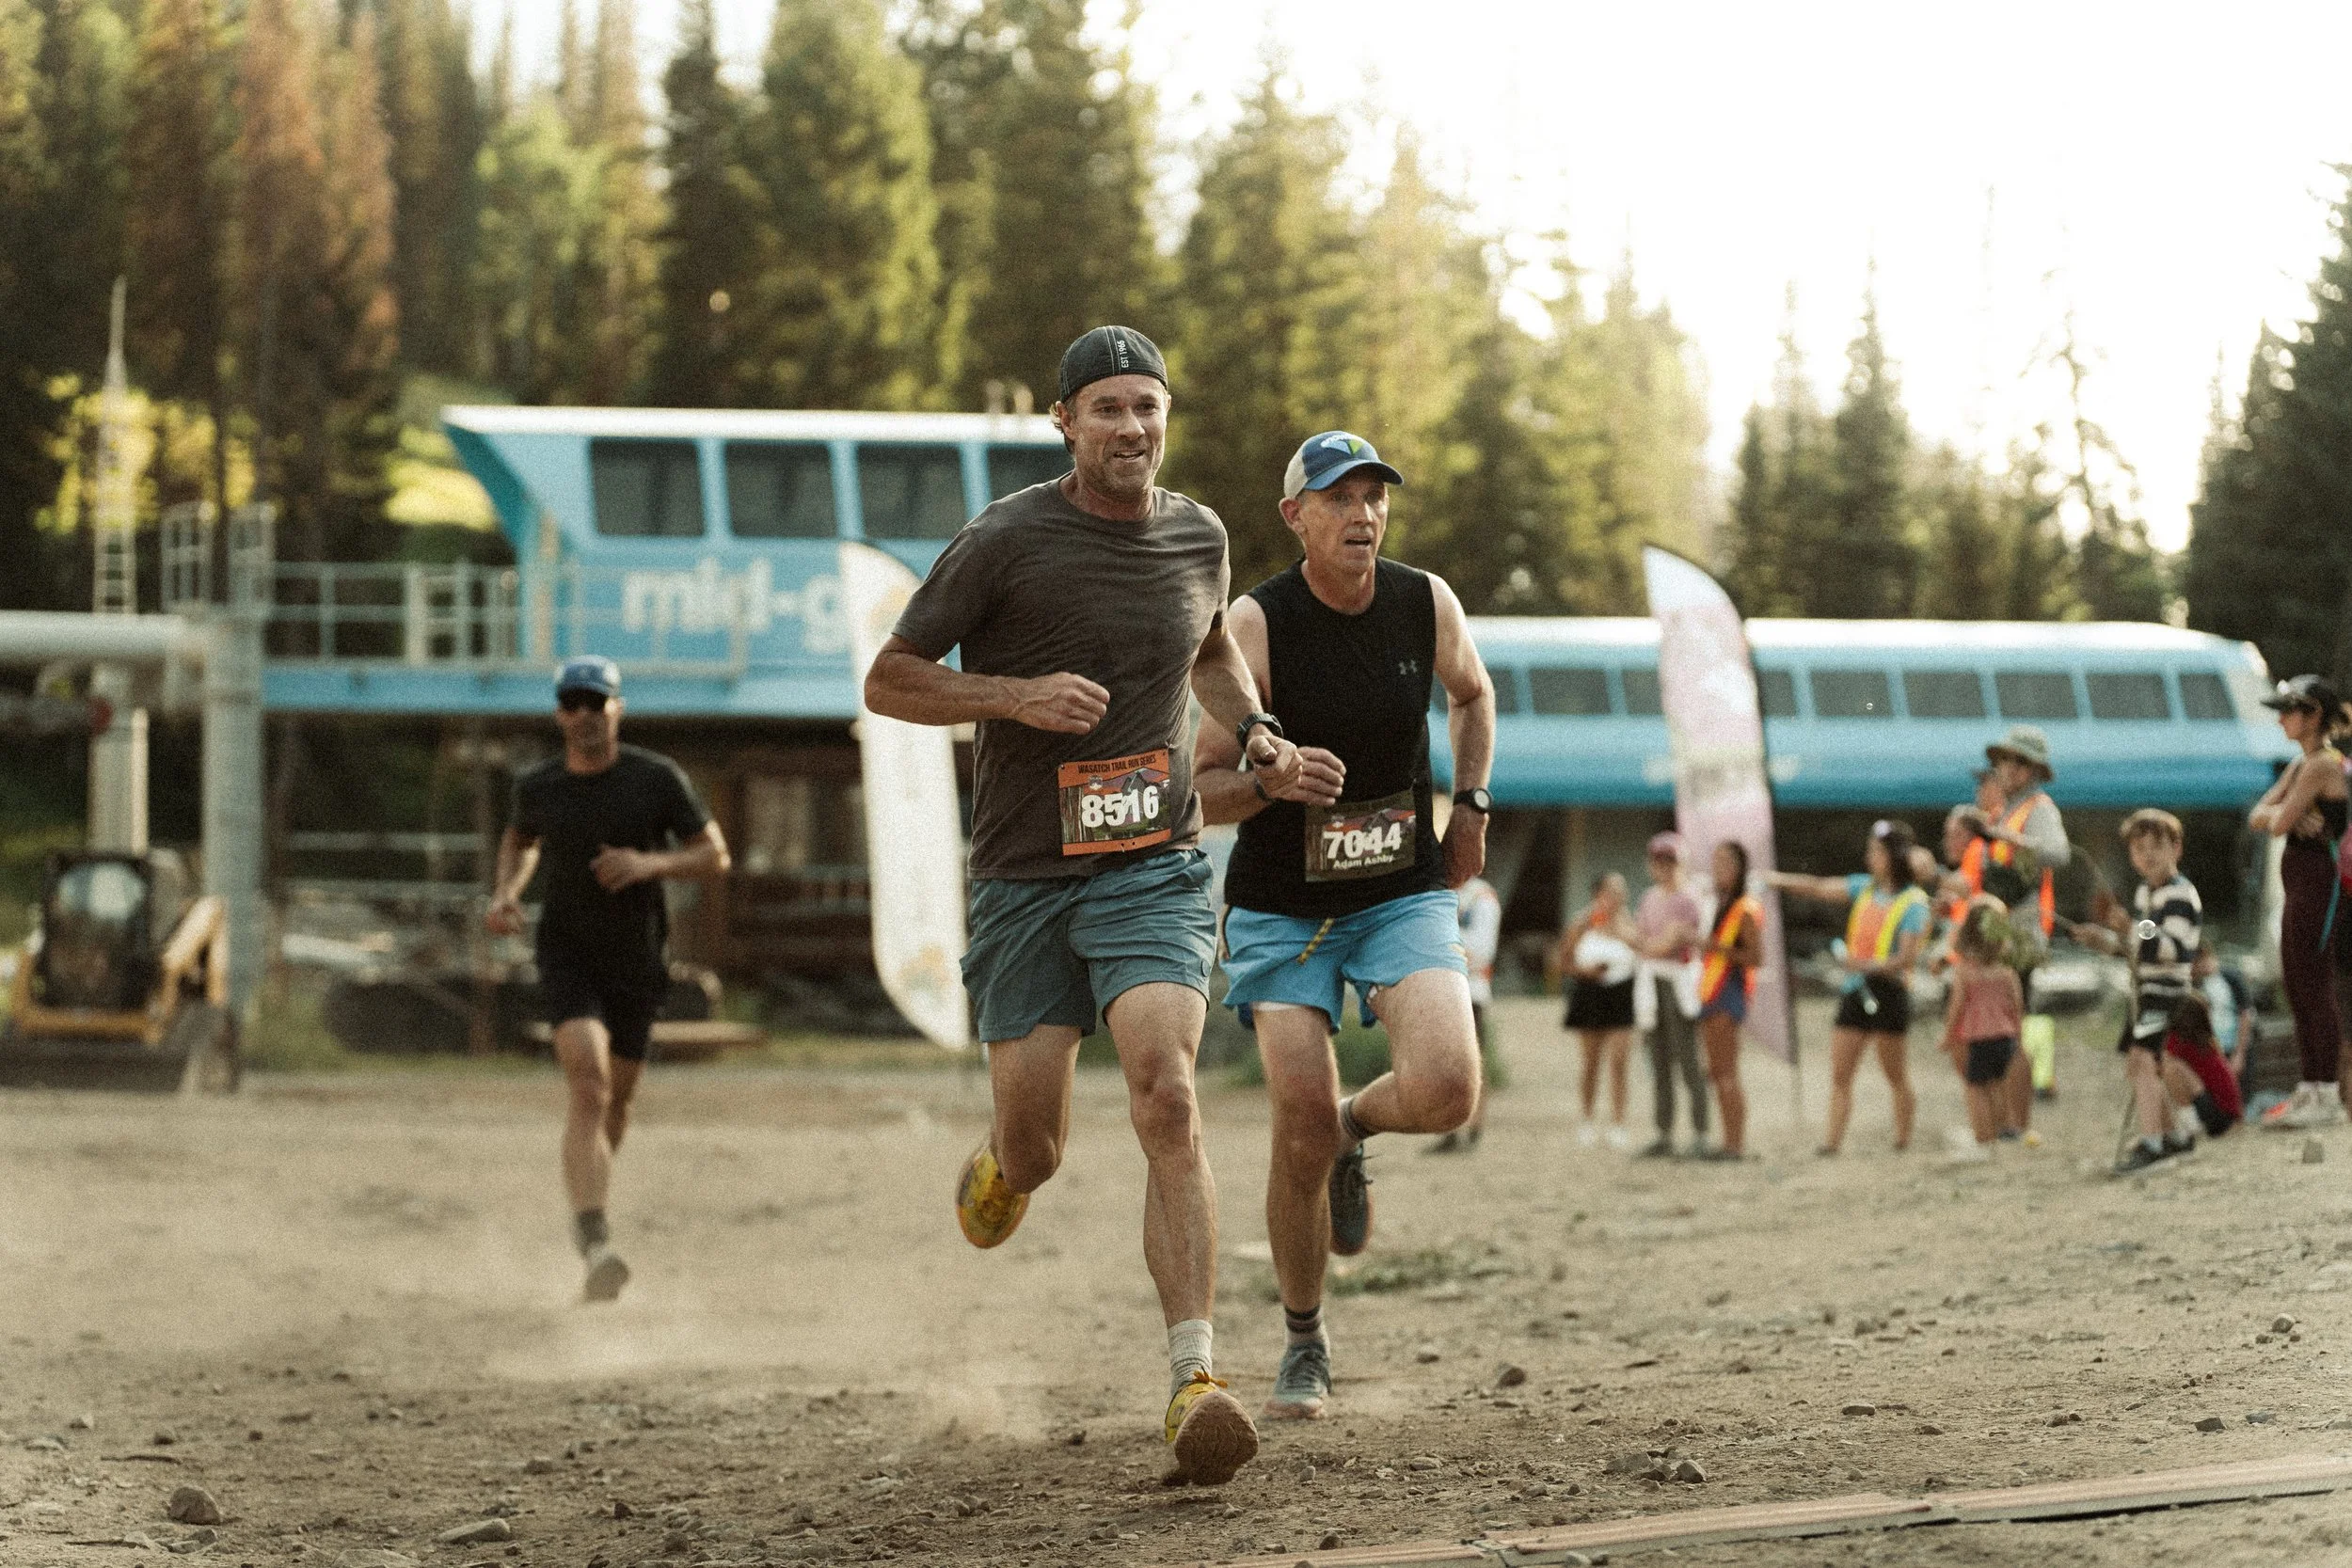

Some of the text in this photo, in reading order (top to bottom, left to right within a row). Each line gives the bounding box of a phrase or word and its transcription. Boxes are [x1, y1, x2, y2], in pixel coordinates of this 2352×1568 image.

[1117, 340, 1129, 368] EST 1965
[1078, 754, 1156, 773] WASATCH TRAIL RUN SERIES
[1081, 785, 1159, 828] 8516
[1323, 822, 1402, 860] 7044
[1333, 859, 1362, 869] Adam
